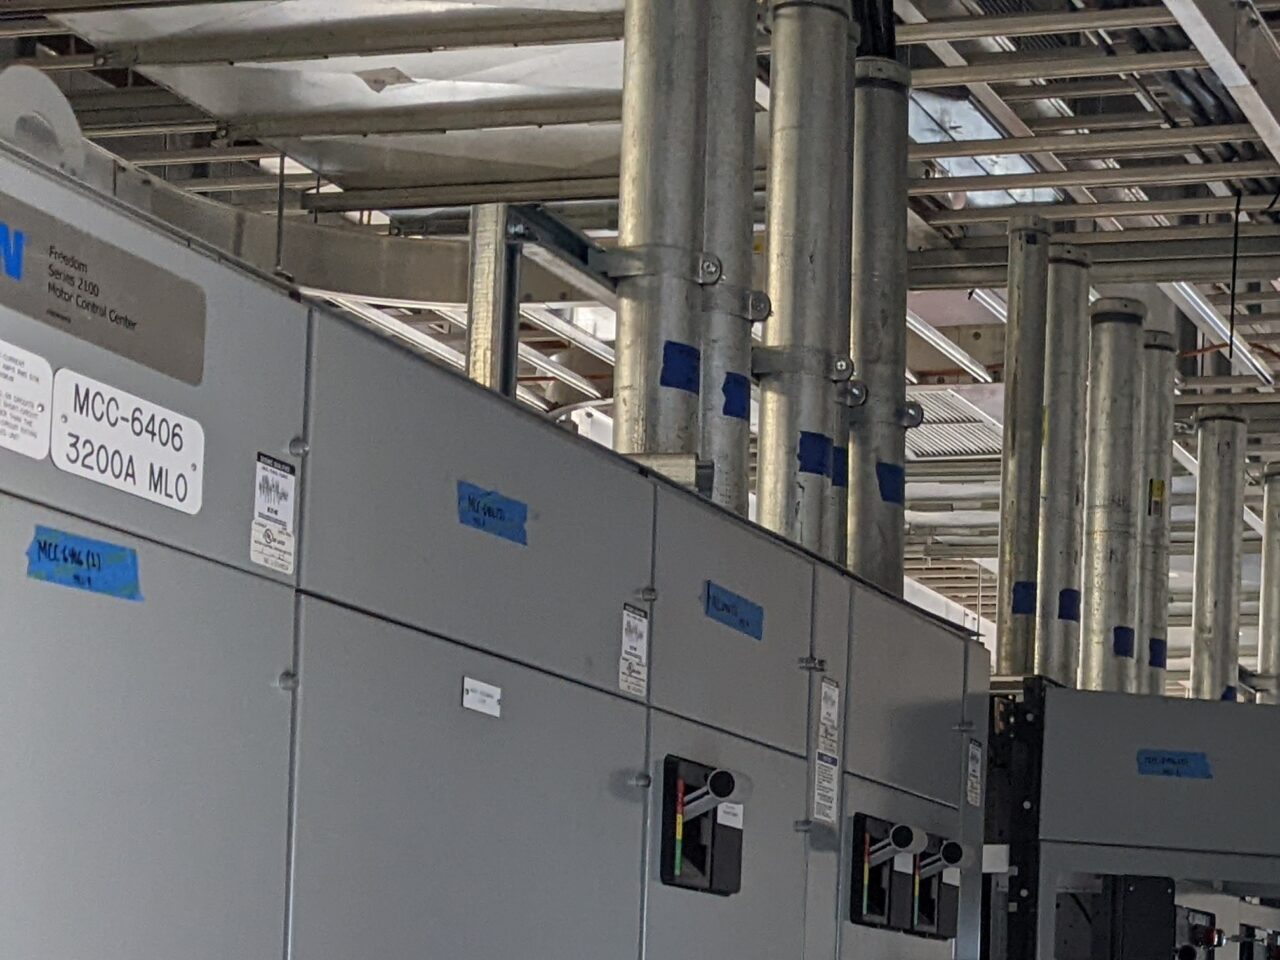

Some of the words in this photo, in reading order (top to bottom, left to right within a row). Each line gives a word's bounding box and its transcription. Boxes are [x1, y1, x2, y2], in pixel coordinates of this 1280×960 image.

[48, 245, 88, 273] Freedom
[48, 263, 75, 287] Series
[78, 278, 99, 297] 2100
[48, 282, 73, 302] Motor
[76, 295, 107, 317] Control
[108, 309, 136, 330] Center
[74, 383, 183, 452] MCC-6406
[66, 432, 136, 486] 3200A
[149, 462, 188, 503] MLO
